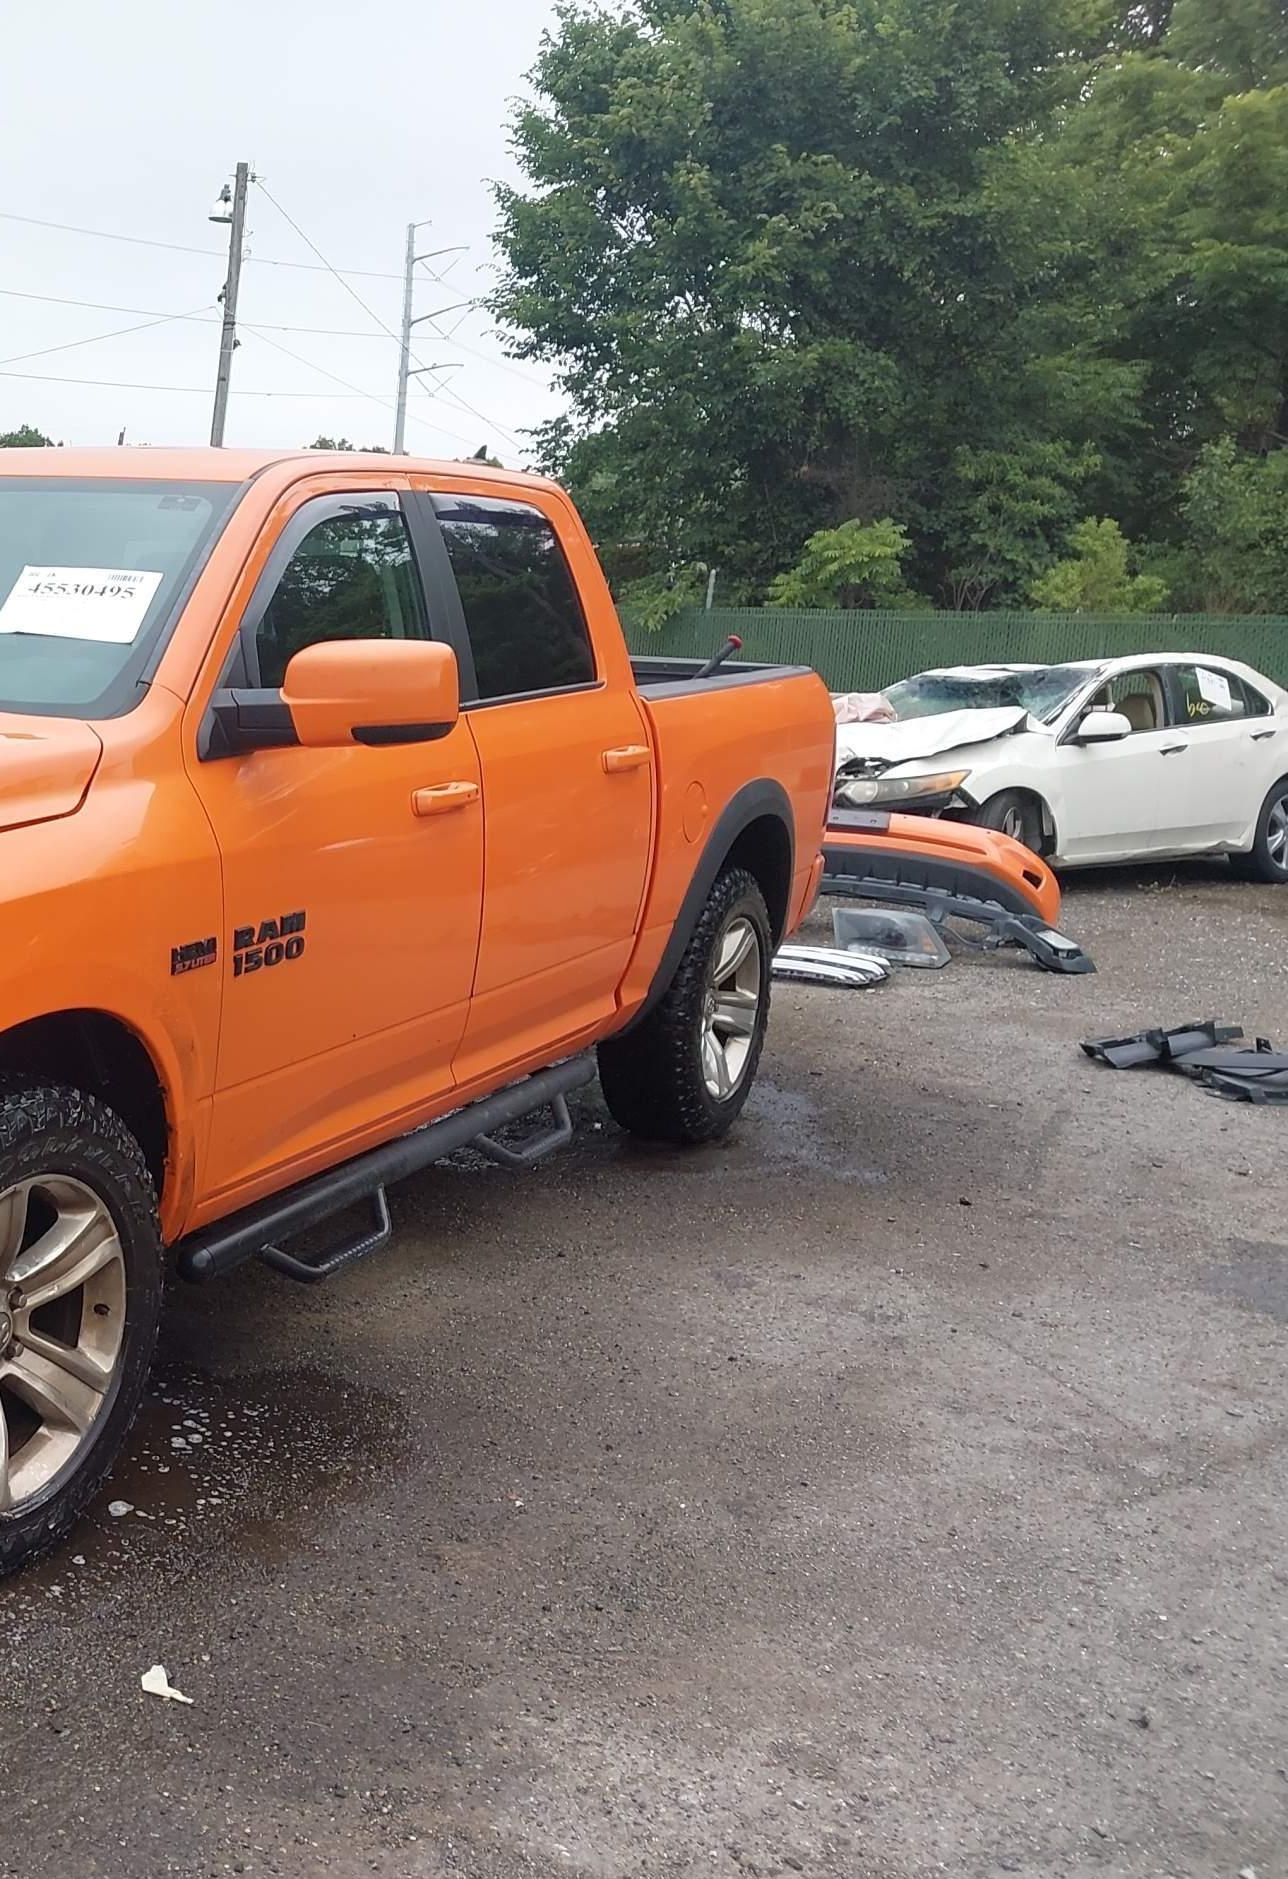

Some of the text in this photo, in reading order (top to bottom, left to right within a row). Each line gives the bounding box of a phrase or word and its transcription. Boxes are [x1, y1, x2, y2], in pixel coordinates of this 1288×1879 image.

[28, 582, 136, 599] 45530495
[234, 910, 306, 951] RAM
[233, 935, 305, 978] 1500
